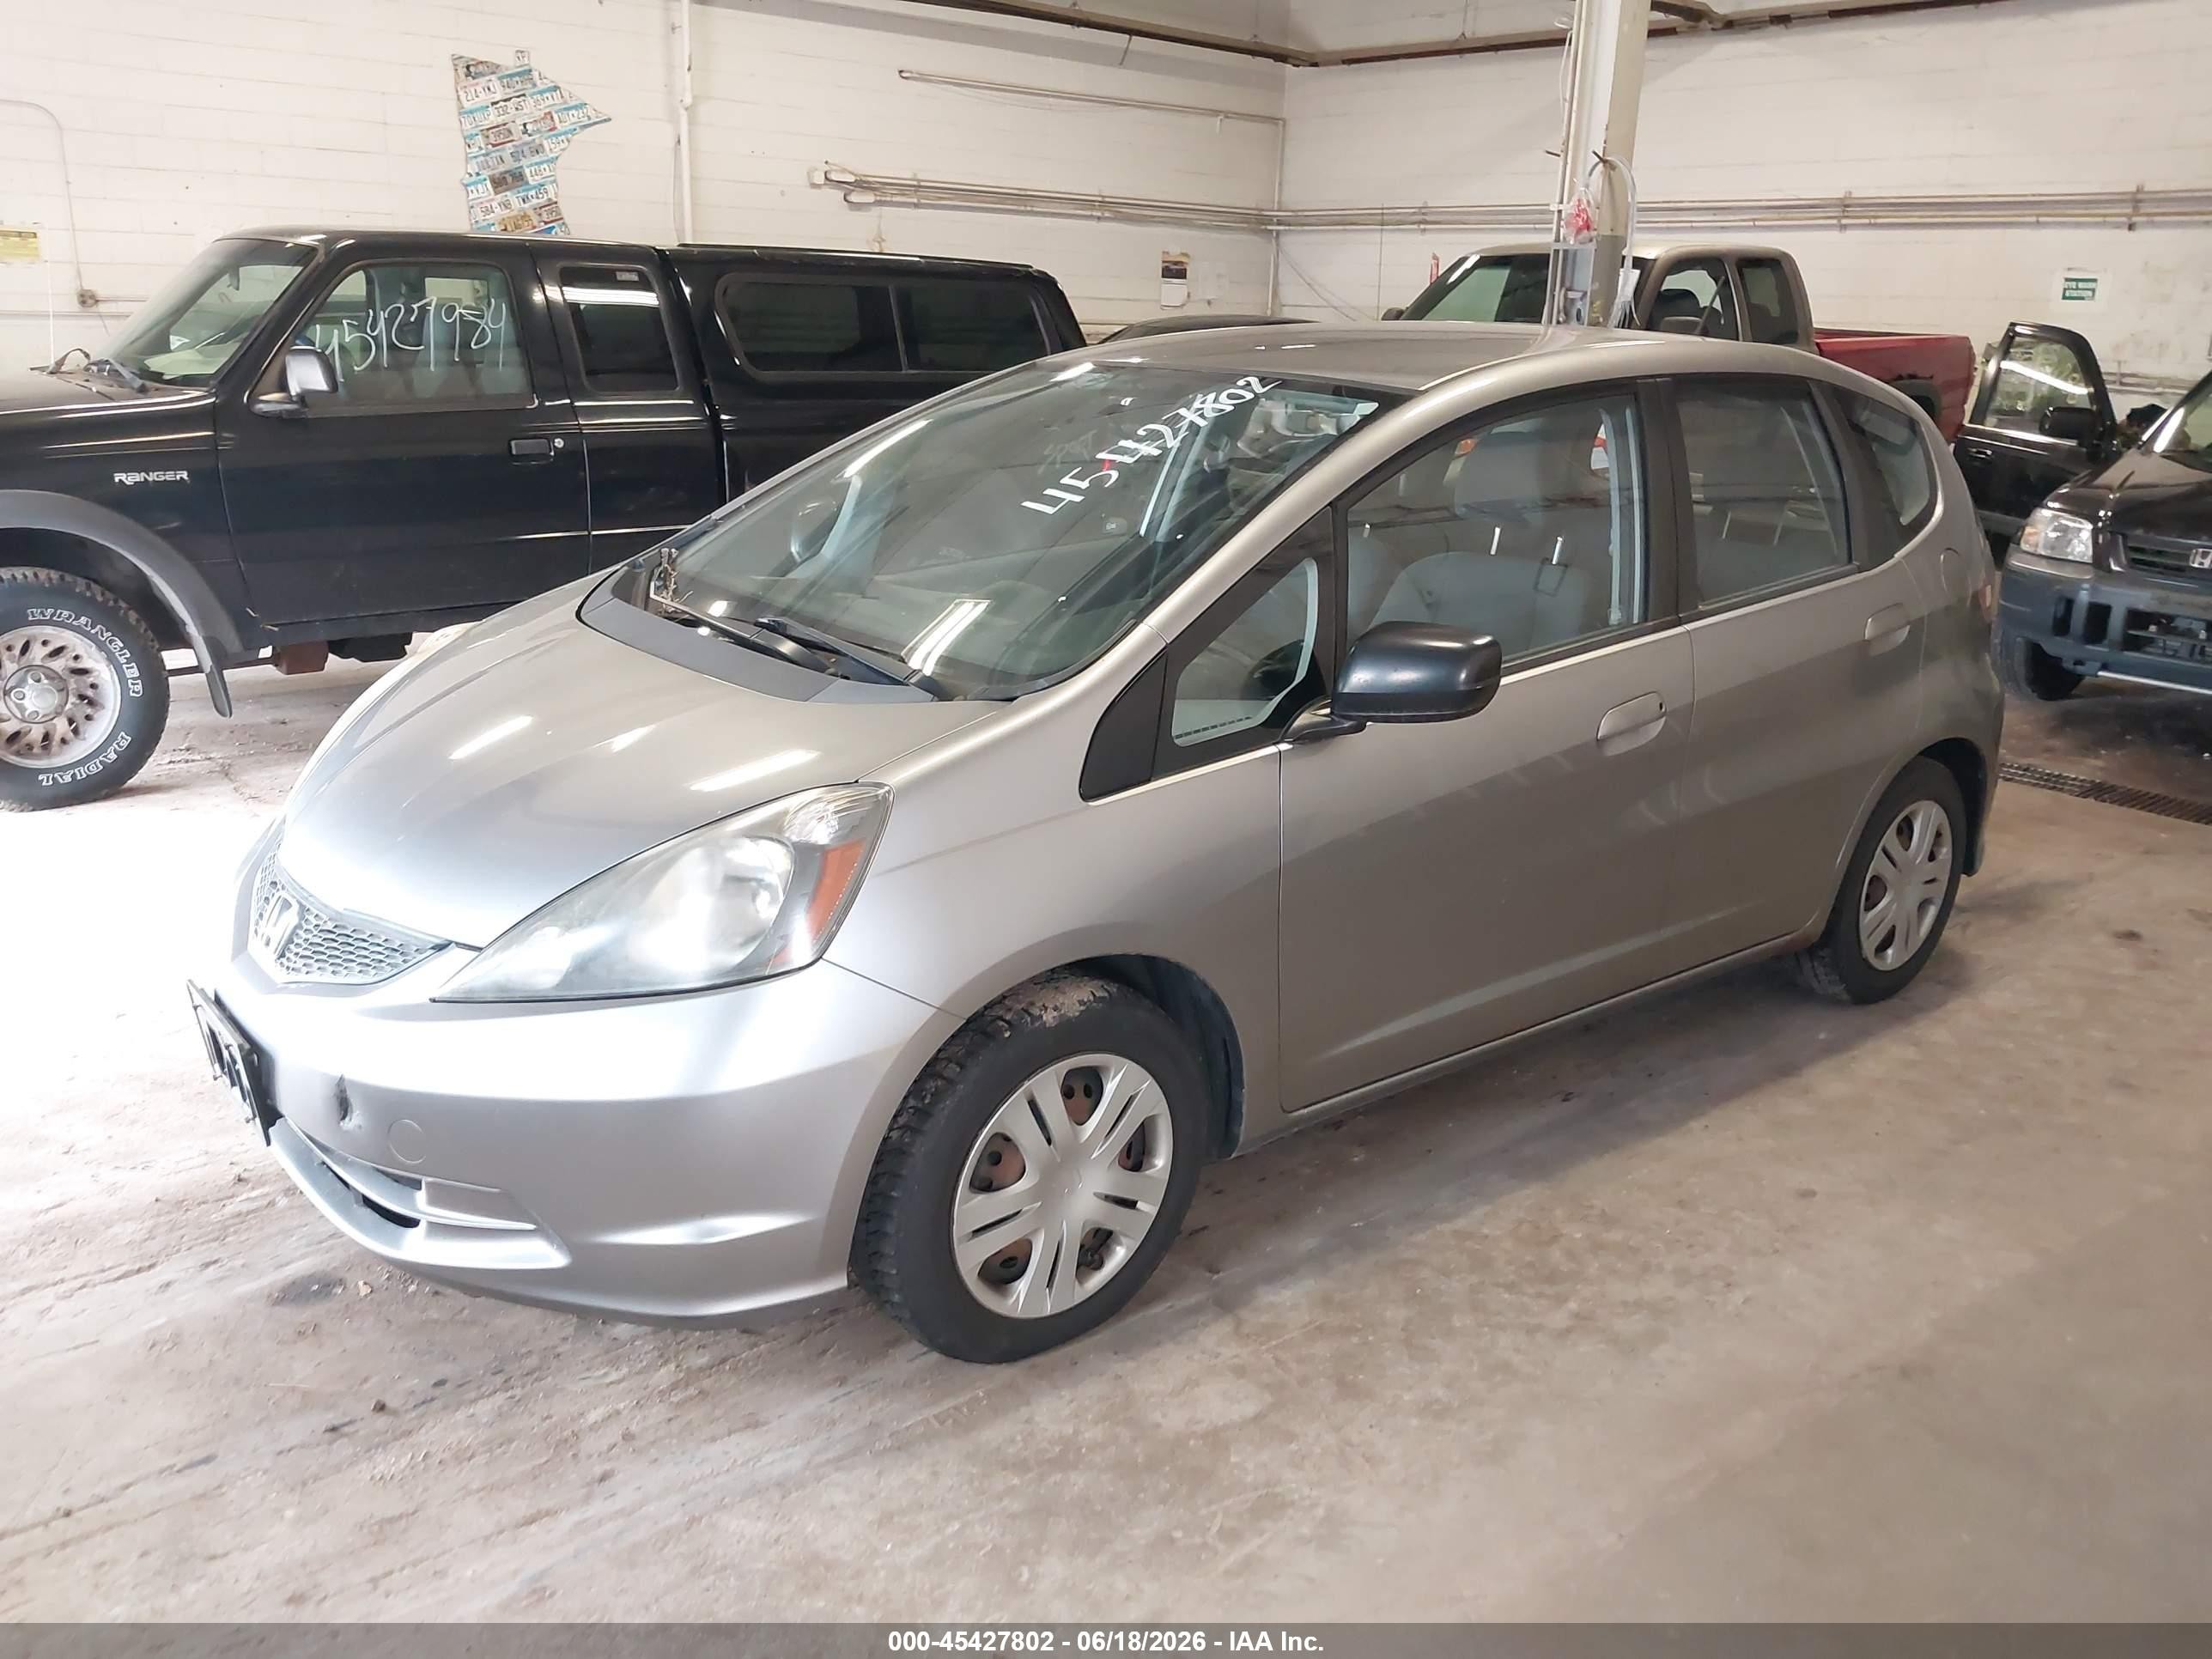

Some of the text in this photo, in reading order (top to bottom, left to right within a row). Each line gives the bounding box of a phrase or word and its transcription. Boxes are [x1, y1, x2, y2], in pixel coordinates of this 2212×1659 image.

[314, 296, 507, 383] 45427984
[112, 470, 189, 485] RANGER
[27, 608, 143, 697] WRANGLER
[39, 732, 131, 786] RADIAL
